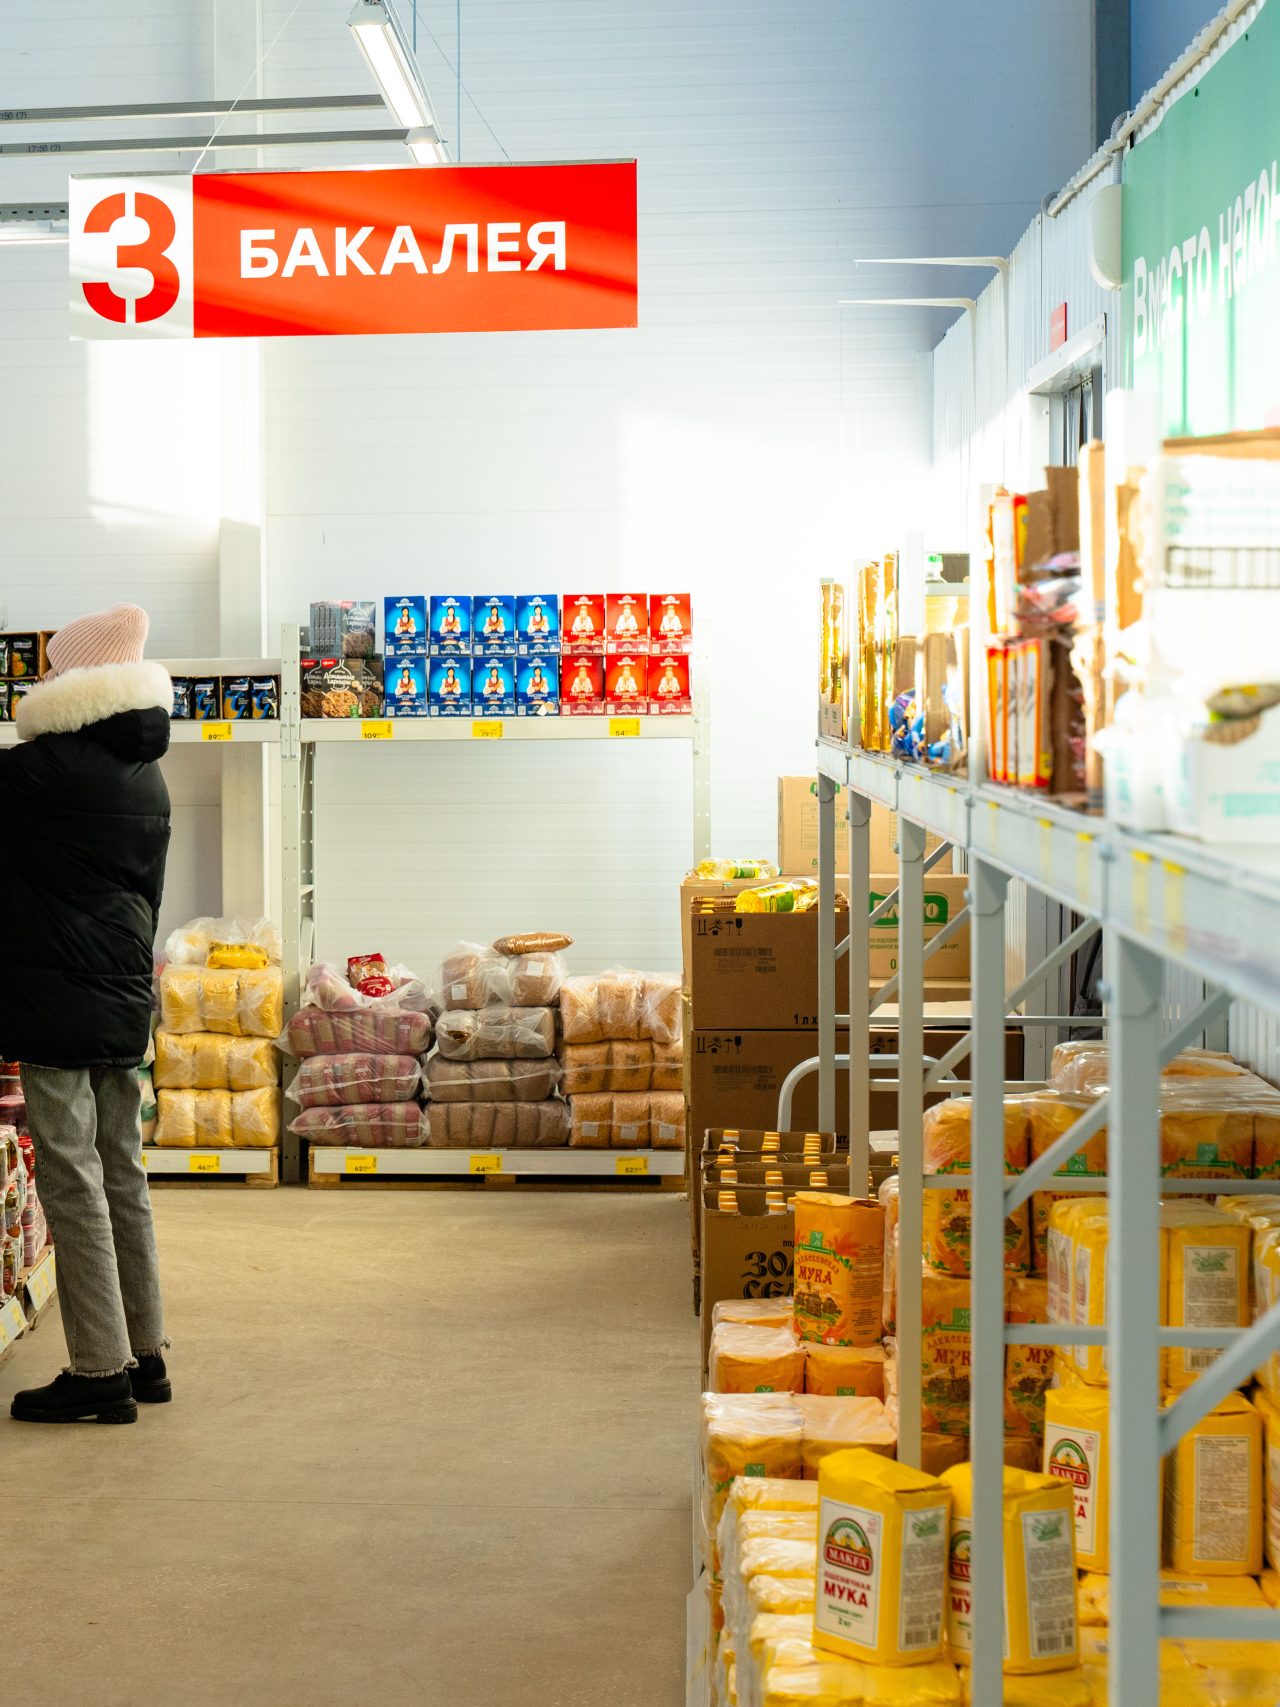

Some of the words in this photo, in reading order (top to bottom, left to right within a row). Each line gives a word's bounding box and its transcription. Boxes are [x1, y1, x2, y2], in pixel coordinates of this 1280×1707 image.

[81, 191, 181, 325] 3
[239, 220, 567, 280] БАКАЛЕЯ
[798, 1265, 833, 1286] МУКА
[823, 1580, 869, 1609] МУКА
